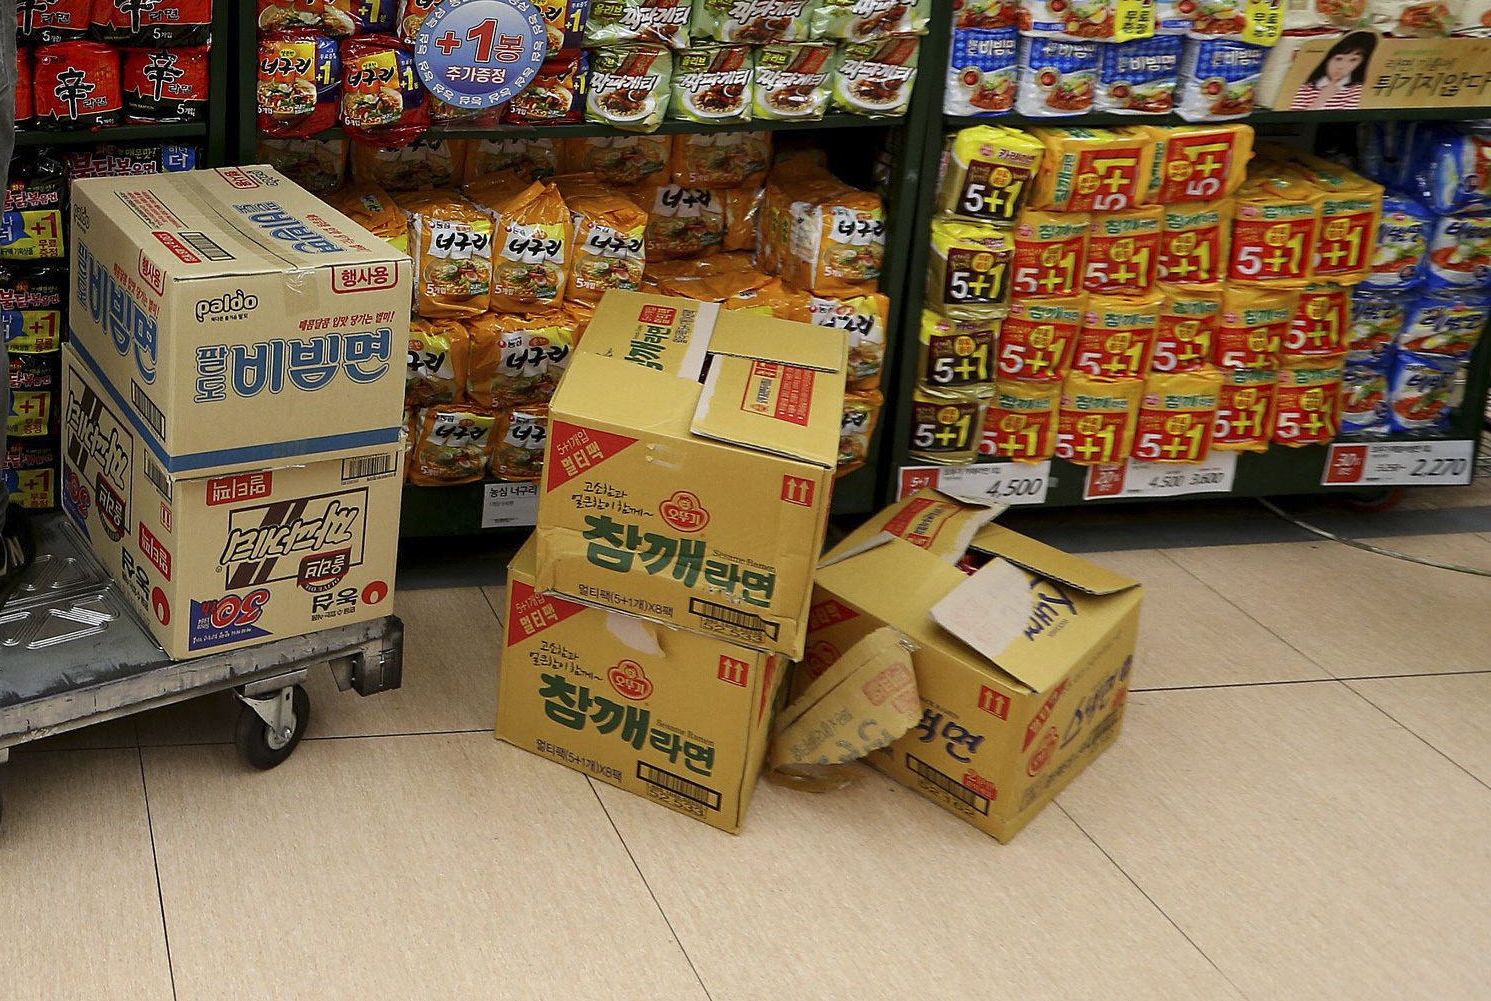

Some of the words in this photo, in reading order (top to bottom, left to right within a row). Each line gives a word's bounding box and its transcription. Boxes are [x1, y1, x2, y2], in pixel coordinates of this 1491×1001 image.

[446, 65, 506, 83] 추가증정
[681, 68, 753, 90] 짜파게티
[963, 179, 1022, 219] 5+1
[434, 229, 489, 253] 너구리
[1235, 229, 1307, 276] 5+1
[341, 267, 389, 288] 행사용
[195, 290, 259, 322] paldo
[298, 317, 331, 331] 매콤달콤
[333, 315, 349, 328] 입맛
[350, 313, 373, 327] 당기는
[375, 311, 396, 324] 별미!
[194, 344, 229, 404] 팔도
[230, 327, 393, 398] 비빔면
[562, 441, 605, 477] 멀티팩
[1409, 458, 1467, 477] 2,270
[213, 475, 267, 502] 멀티팩
[490, 486, 508, 498] 농심
[510, 485, 538, 498] 너구리
[584, 481, 628, 500] 고소함과
[985, 477, 1043, 498] 4,500
[669, 509, 701, 527] 오뚜기
[220, 499, 360, 565] 짜파게티
[305, 553, 346, 579] 올리브
[583, 515, 777, 607] 참깨라면
[312, 587, 359, 613] 농심
[518, 603, 560, 635] 멀티팩
[540, 672, 716, 778] 참깨라면
